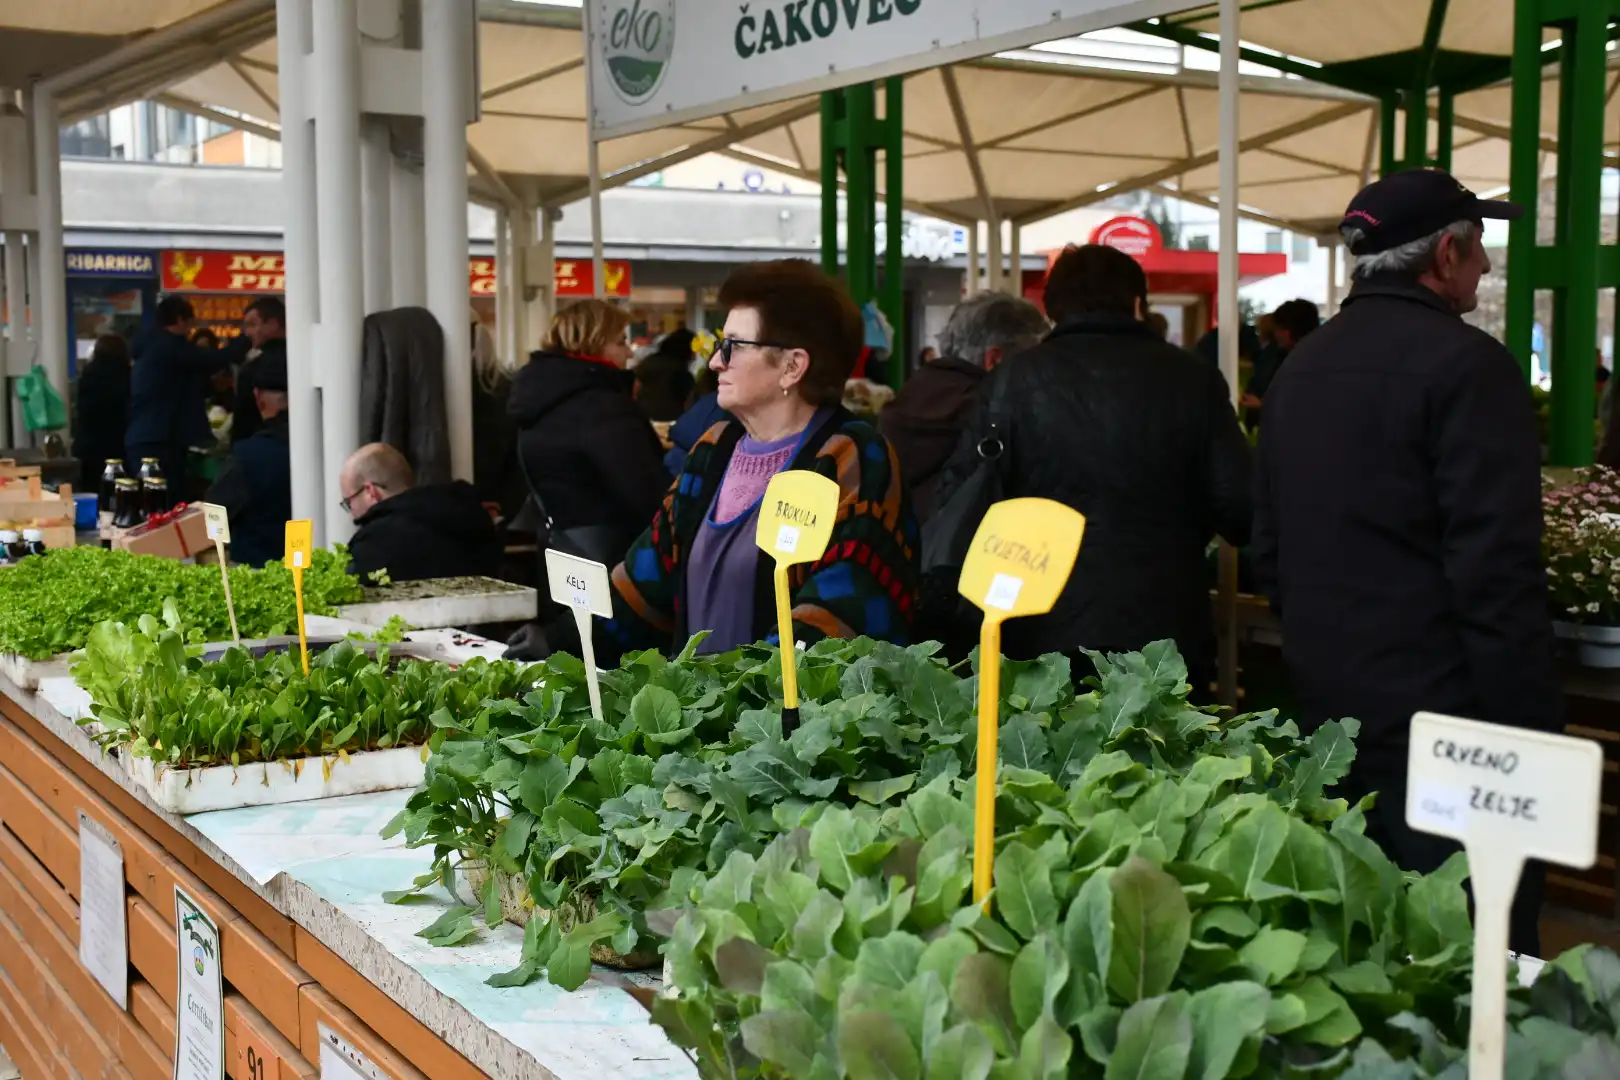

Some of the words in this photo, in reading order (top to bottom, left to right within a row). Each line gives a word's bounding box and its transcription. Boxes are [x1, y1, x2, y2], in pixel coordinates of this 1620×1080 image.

[611, 0, 661, 52] eko
[67, 252, 153, 272] RIBARNICA
[775, 500, 817, 528] BROKULA
[566, 574, 586, 591] KELJ
[1432, 738, 1519, 775] CRVENO
[1469, 784, 1538, 822] ZELJE
[247, 1045, 264, 1080] 91
